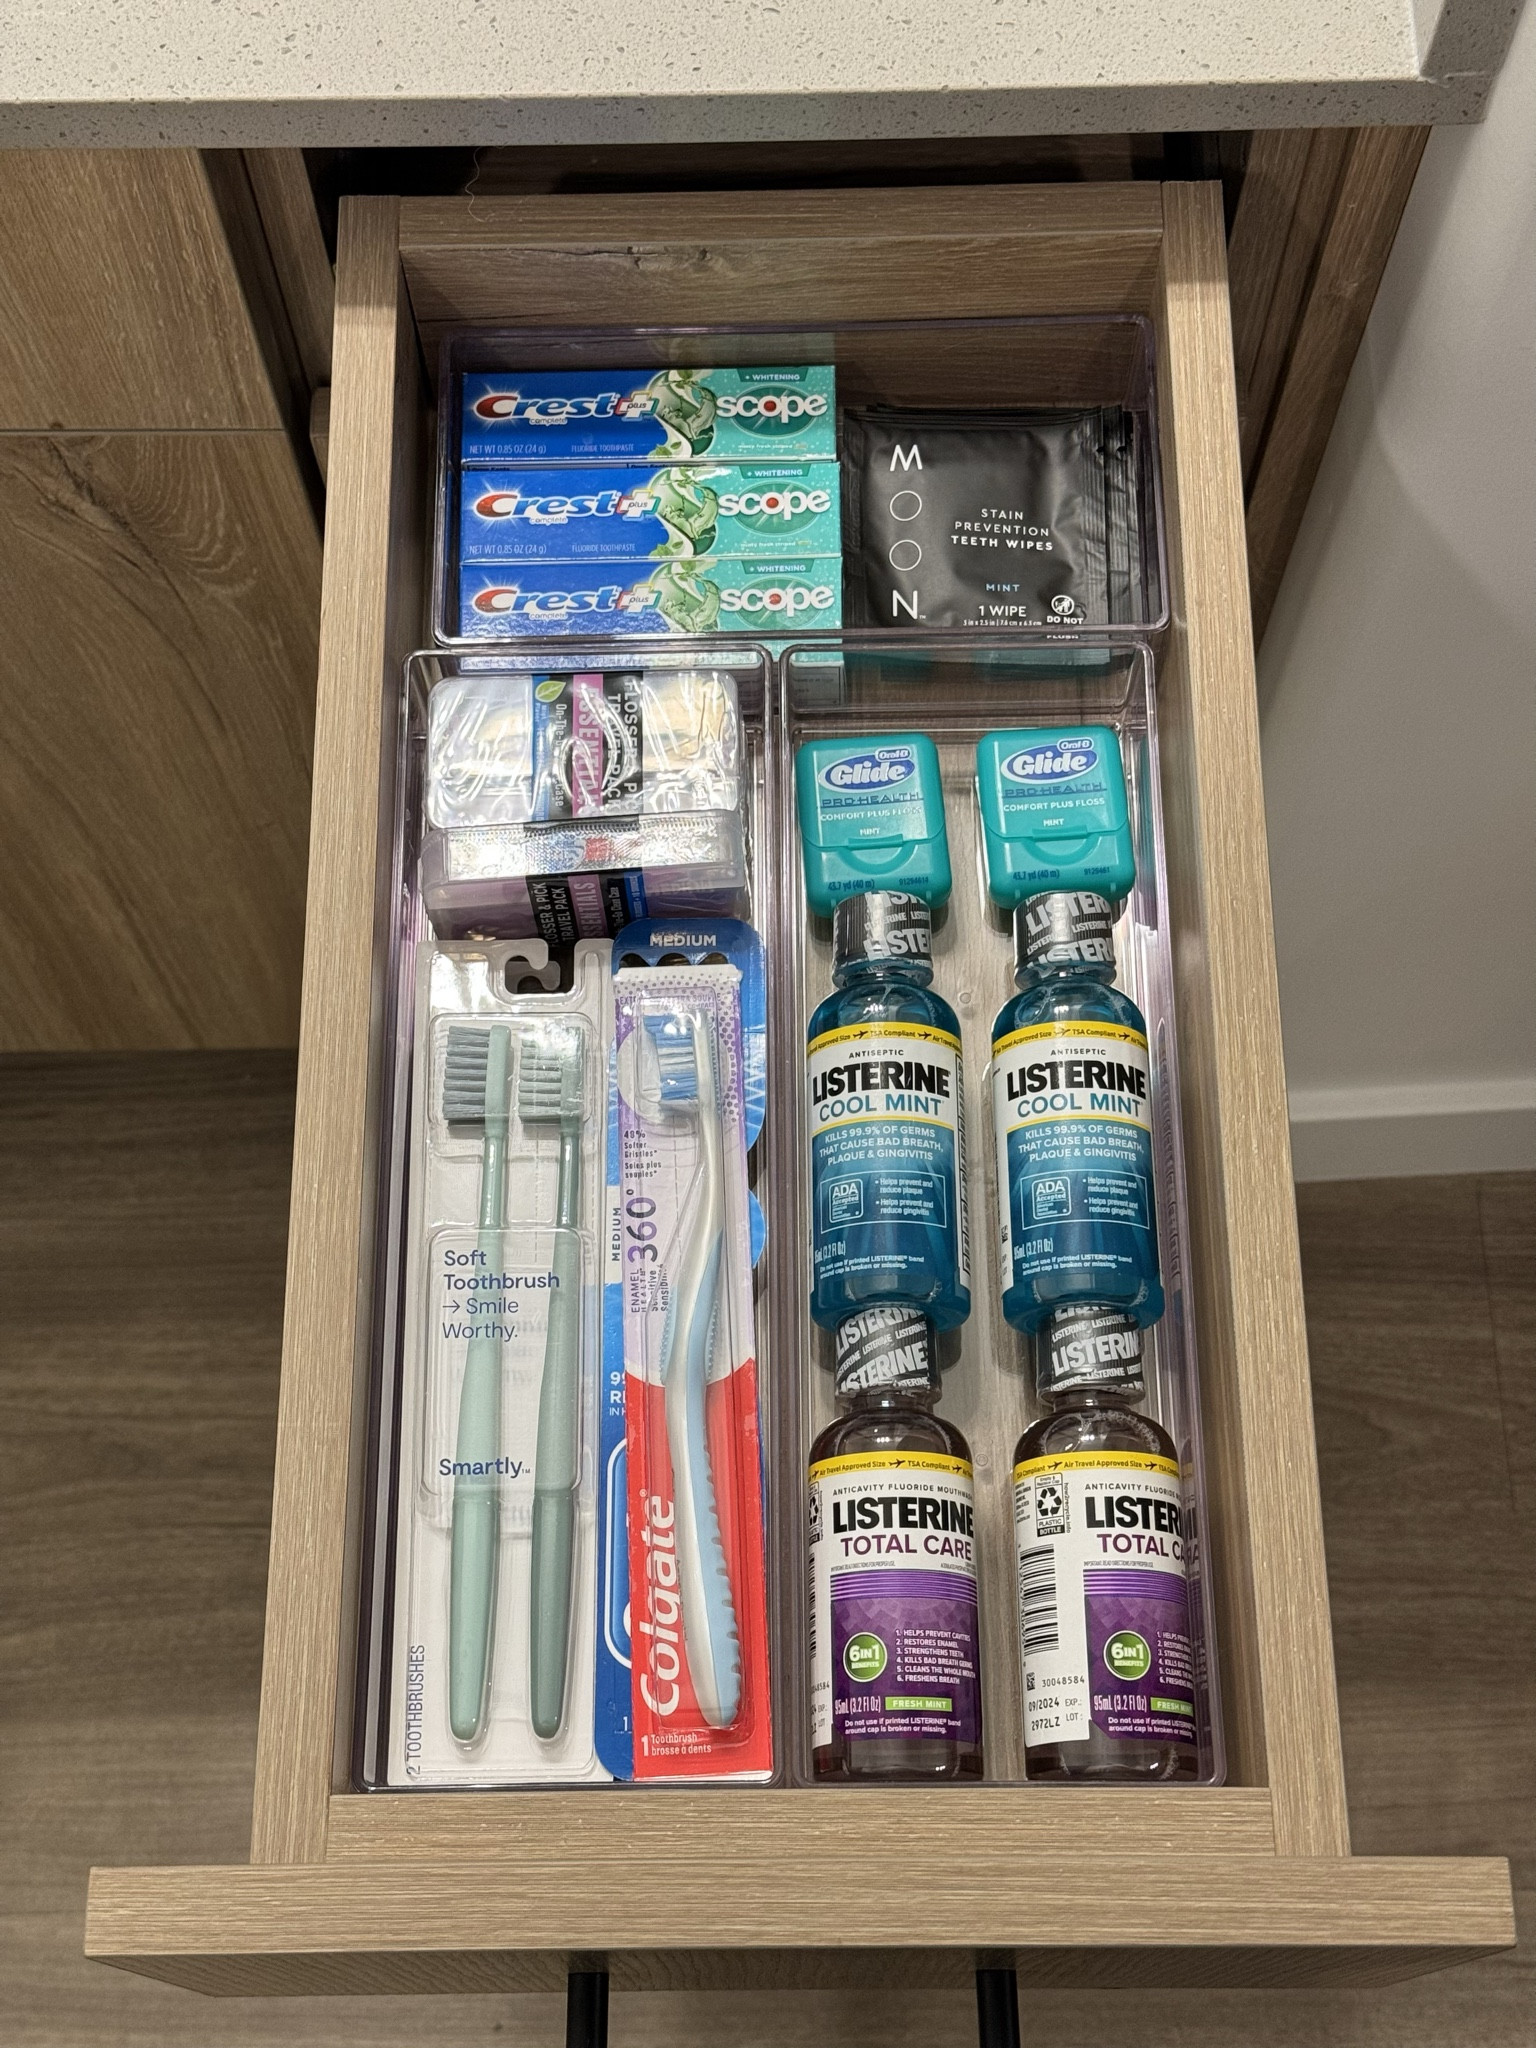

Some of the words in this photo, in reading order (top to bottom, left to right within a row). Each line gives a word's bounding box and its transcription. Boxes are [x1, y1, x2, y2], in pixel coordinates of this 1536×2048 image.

[474, 392, 617, 418] Crest
[717, 394, 827, 423] scope
[470, 445, 483, 454] NET
[485, 445, 496, 454] WT
[497, 445, 512, 454] 0.85
[514, 445, 523, 454] OZ
[526, 445, 537, 454] (24
[538, 445, 546, 455] g)
[474, 490, 617, 518] Crest
[719, 490, 831, 520] scope
[981, 508, 1024, 520] STAIN
[954, 521, 1049, 537] PREVENTION
[469, 545, 482, 554] NET
[485, 545, 496, 554] WT
[497, 545, 512, 554] 0.85
[514, 545, 523, 554] OZ
[526, 544, 537, 554] (24
[538, 544, 546, 555] g)
[951, 535, 998, 548] TEETH
[1006, 539, 1053, 551] WIPES
[757, 564, 806, 572] WHITENING
[986, 583, 1020, 592] MINT
[474, 585, 616, 613] Crest
[629, 595, 649, 604] plus
[720, 587, 834, 617] scope
[979, 605, 984, 616] 1
[988, 606, 1026, 617] WIPE
[1047, 616, 1060, 624] DO
[1063, 616, 1084, 625] NOT
[830, 761, 906, 785] Glide
[1013, 753, 1088, 776] Glide
[1003, 802, 1048, 812] COMFORT
[1051, 800, 1074, 809] PLUS
[1076, 798, 1105, 807] FLOSS
[820, 811, 866, 821] COMFORT
[868, 809, 890, 818] PLUS
[892, 807, 922, 816] FLOSS
[859, 827, 880, 836] MINT
[533, 882, 548, 902] PICK
[551, 888, 568, 910] PACK
[574, 882, 602, 937] SSENTIALS
[558, 912, 575, 941] TRAVEL
[650, 935, 717, 947] MEDIUM
[849, 1050, 904, 1058] ANTISEPTIC
[813, 1061, 950, 1106] LISTERINE
[1007, 1060, 1146, 1101] LISTERINE
[819, 1095, 877, 1122] COOL
[885, 1094, 942, 1116] MINT
[1017, 1094, 1082, 1118] COOL
[1090, 1093, 1142, 1117] MINT
[825, 1130, 848, 1144] KILLS
[850, 1127, 880, 1137] 99.9%
[883, 1126, 898, 1134] OF
[900, 1126, 935, 1138] GERMS
[1025, 1128, 1052, 1139] KILLS
[1053, 1125, 1086, 1133] 99.9%
[1089, 1125, 1103, 1133] OF
[1106, 1126, 1137, 1138] GERMS
[819, 1143, 840, 1158] THAT
[841, 1138, 874, 1150] CAUSE
[877, 1138, 900, 1146] BAD
[903, 1138, 943, 1152] BREATH,
[1018, 1141, 1041, 1153] THAT
[1044, 1137, 1080, 1147] CAUSE
[1083, 1137, 1106, 1145] BAD
[1108, 1137, 1144, 1154] BREATH,
[827, 1151, 865, 1166] PLAQUE
[867, 1150, 874, 1158] &
[877, 1149, 933, 1160] GINGIVITIS
[1029, 1150, 1071, 1162] PLAQUE
[1074, 1149, 1081, 1157] &
[1084, 1149, 1137, 1161] GINGIVITIS
[832, 1183, 859, 1198] ADA
[1036, 1180, 1065, 1194] ADA
[612, 1207, 621, 1261] MEDIUM
[443, 1250, 486, 1267] Soft
[444, 1272, 560, 1290] Toothbrush
[631, 1269, 640, 1313] ENAMEL
[466, 1298, 519, 1315] Smile
[443, 1322, 518, 1342] Worthy.
[439, 1457, 523, 1478] Smartly
[827, 1465, 841, 1474] Travel
[842, 1462, 871, 1472] Approved
[922, 1461, 950, 1470] Compliant
[833, 1484, 884, 1496] ANTICAVITY
[888, 1484, 934, 1492] FLUORIDE
[937, 1486, 973, 1499] MOUTHWAS
[1145, 1485, 1175, 1499] FLUORIDE
[833, 1497, 974, 1538] LISTERINE
[1039, 1518, 1062, 1527] PLASTIC
[1039, 1527, 1062, 1535] BOTTLE
[840, 1534, 918, 1557] TOTAL
[923, 1535, 972, 1561] CARE
[1097, 1534, 1169, 1557] TOTAL
[640, 1495, 681, 1716] Colgate
[904, 1648, 948, 1656] STRENGTHENS
[949, 1650, 964, 1658] TEETH
[851, 1661, 879, 1669] BENEFITS
[938, 1658, 958, 1666] BREATH
[1114, 1659, 1144, 1667] BENEFITS
[905, 1675, 938, 1683] FRESHENS
[1042, 1675, 1085, 1688] 30048584
[407, 1645, 425, 1762] TOOTHBRUSHES
[1028, 1697, 1059, 1712] 09/2024
[1094, 1696, 1113, 1711] 95mL
[1114, 1695, 1128, 1712] (3.2
[1136, 1695, 1147, 1712] Oz)
[1031, 1716, 1060, 1731] 2972LZ
[1066, 1713, 1078, 1721] LOT
[1134, 1725, 1146, 1733] cap
[642, 1735, 648, 1756] 1
[651, 1733, 698, 1744] Toothbrush
[652, 1745, 679, 1755] brosse
[688, 1745, 712, 1754] dents
[406, 1766, 420, 1775] 2
